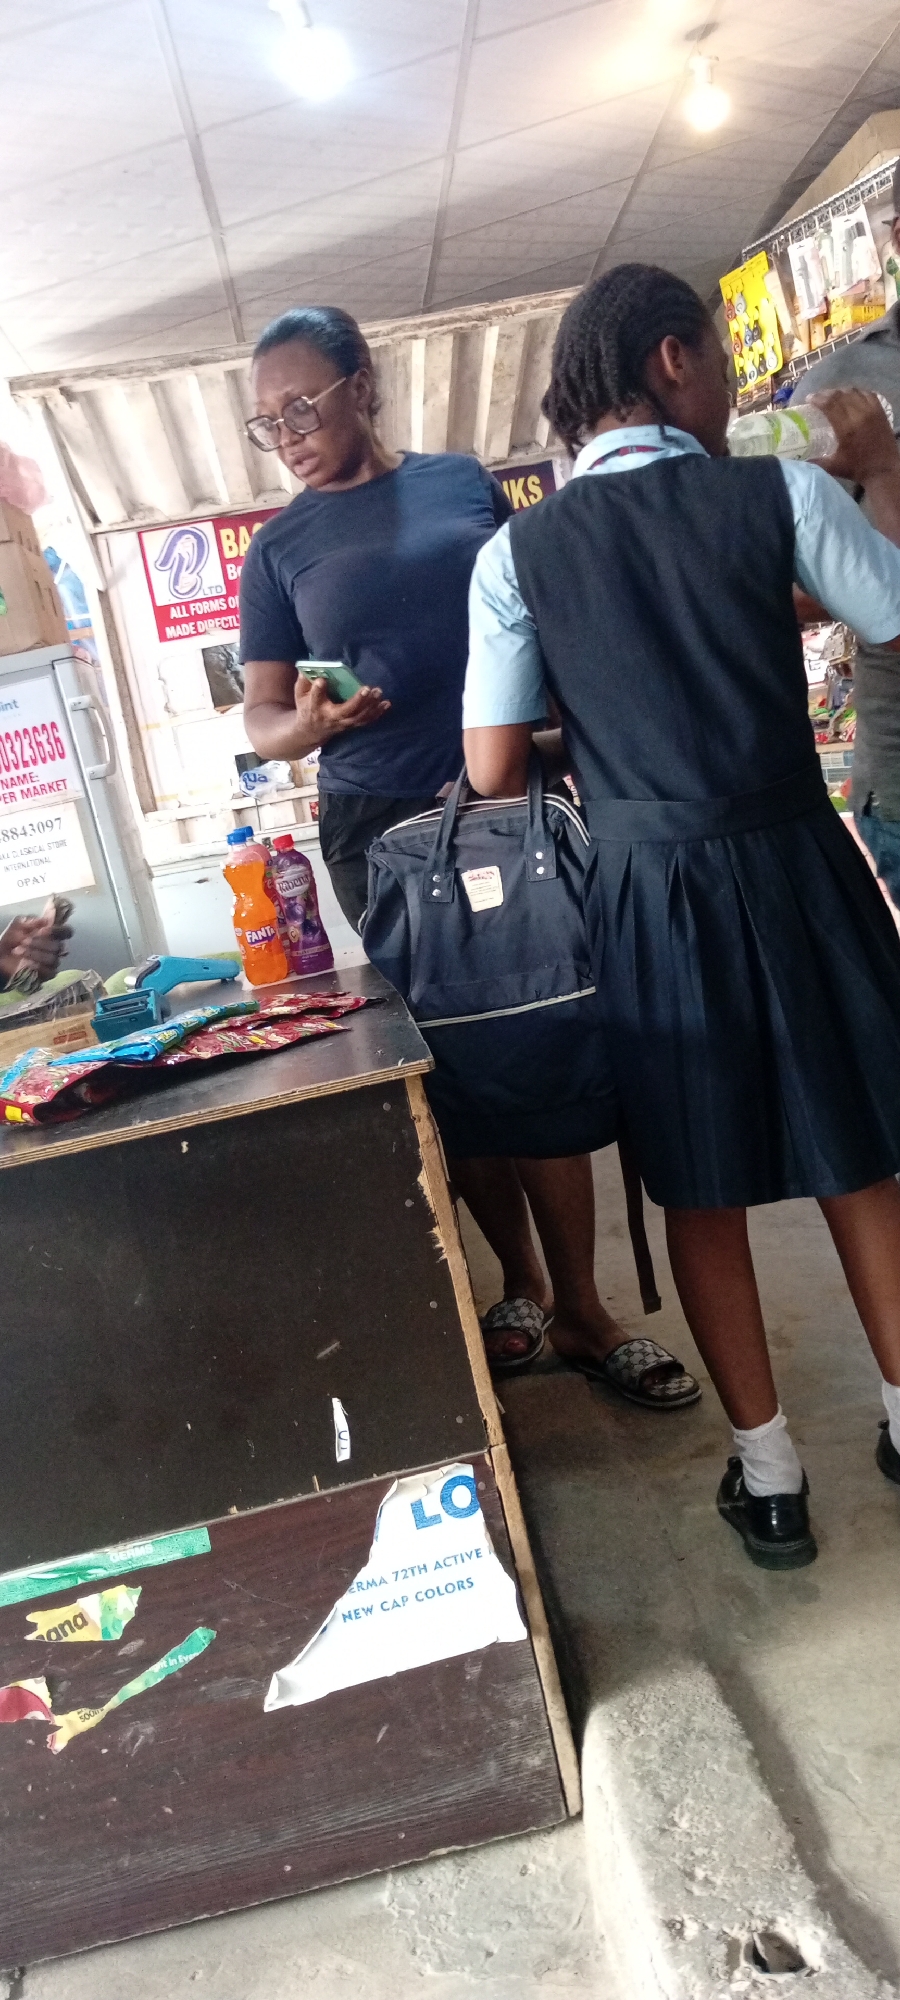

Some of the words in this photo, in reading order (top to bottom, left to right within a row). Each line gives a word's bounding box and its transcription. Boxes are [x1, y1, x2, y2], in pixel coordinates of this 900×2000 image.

[202, 585, 223, 596] LTD
[170, 605, 190, 619] ALL
[190, 598, 227, 616] FORMS
[165, 621, 197, 639] MADE
[0, 721, 66, 774] 0323636
[0, 791, 18, 804] ER
[20, 778, 68, 800] MARKET
[0, 817, 62, 843] 8843097
[47, 839, 68, 851] STORE
[17, 872, 47, 888] OPAY
[392, 1563, 428, 1582] 72TH
[433, 1547, 484, 1572] ACTIVE
[341, 1604, 374, 1624] NEW
[380, 1595, 409, 1612] CAP
[414, 1577, 475, 1602] COLORS
